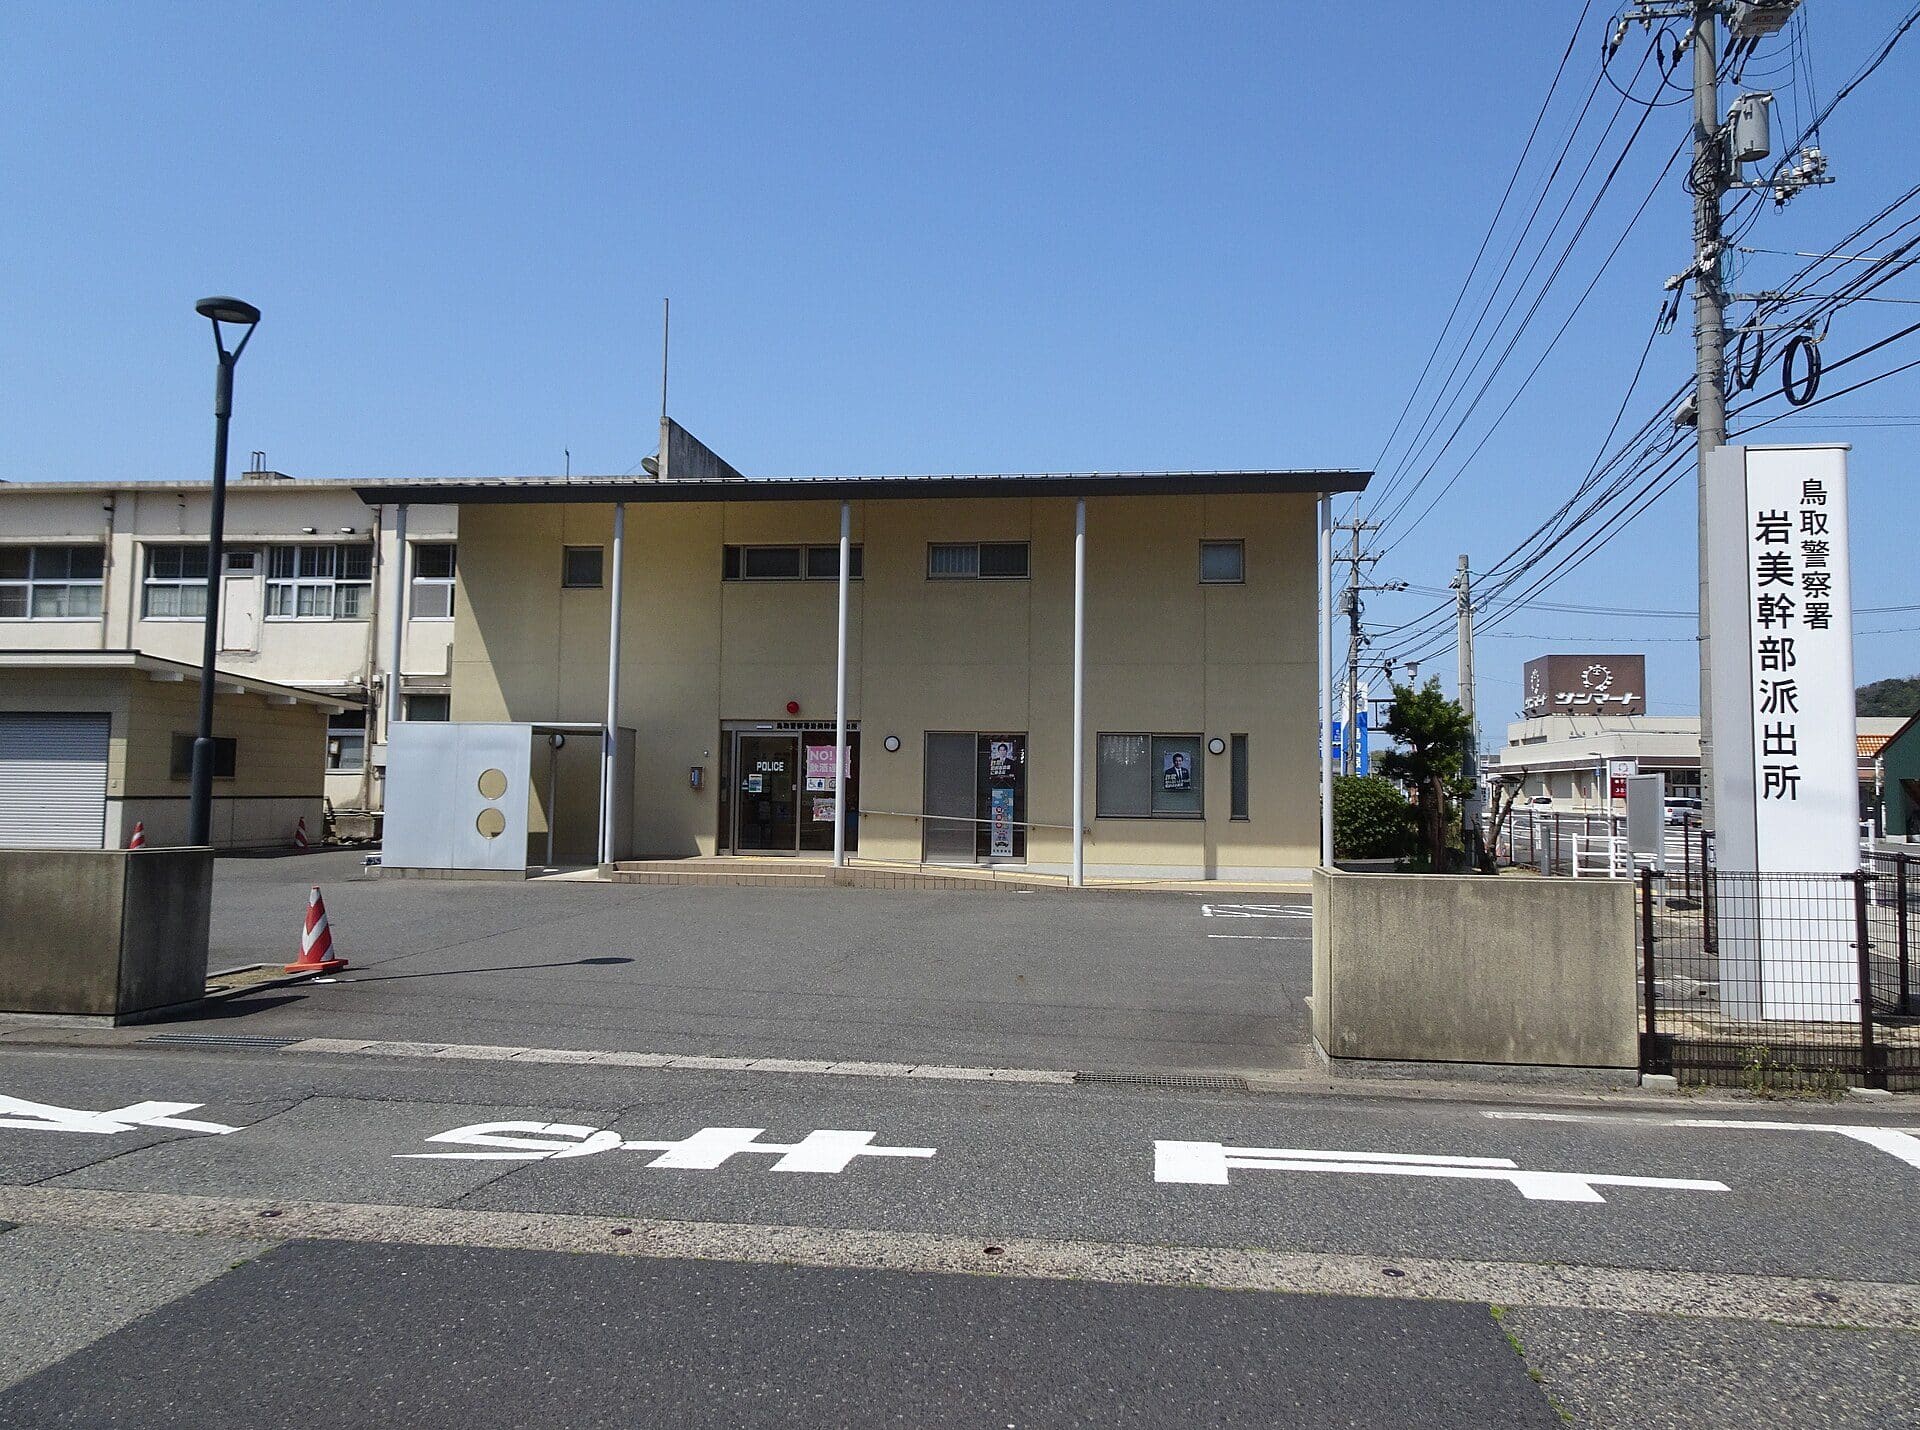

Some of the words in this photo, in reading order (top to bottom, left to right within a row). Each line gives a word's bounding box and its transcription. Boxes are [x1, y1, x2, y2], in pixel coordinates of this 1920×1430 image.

[1799, 478, 1833, 631] 鳥取警察署
[1755, 509, 1801, 801] 岩美幹部派出所
[1555, 692, 1641, 705] サンマート
[756, 761, 784, 772] POLICE
